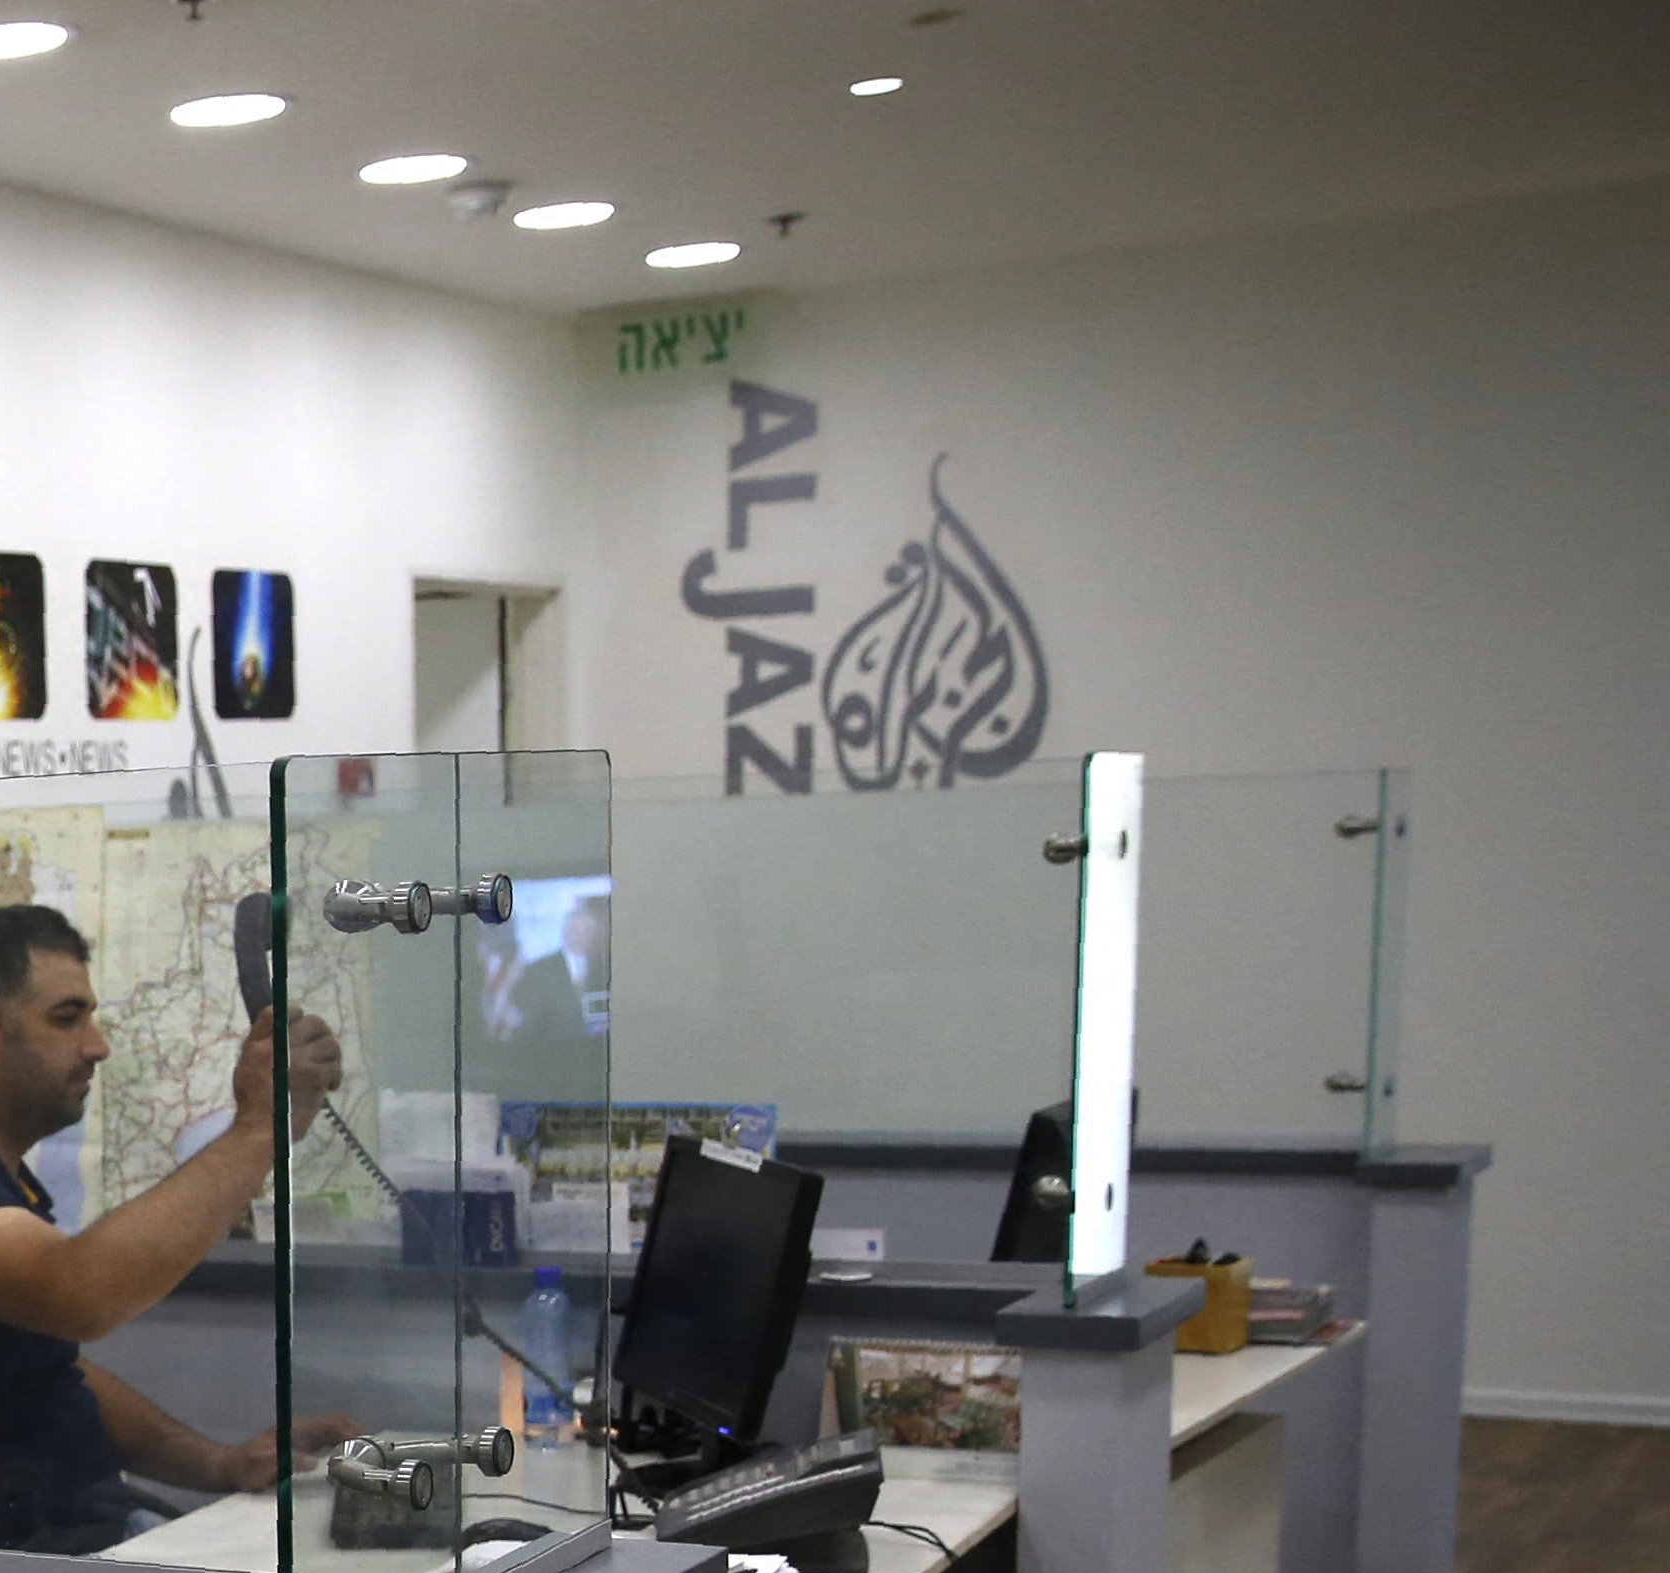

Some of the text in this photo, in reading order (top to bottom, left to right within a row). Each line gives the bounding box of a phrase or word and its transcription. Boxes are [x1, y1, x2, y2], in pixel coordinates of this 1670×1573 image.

[617, 309, 748, 373] יציאה
[729, 379, 820, 551] AL
[68, 738, 129, 776] NEWS
